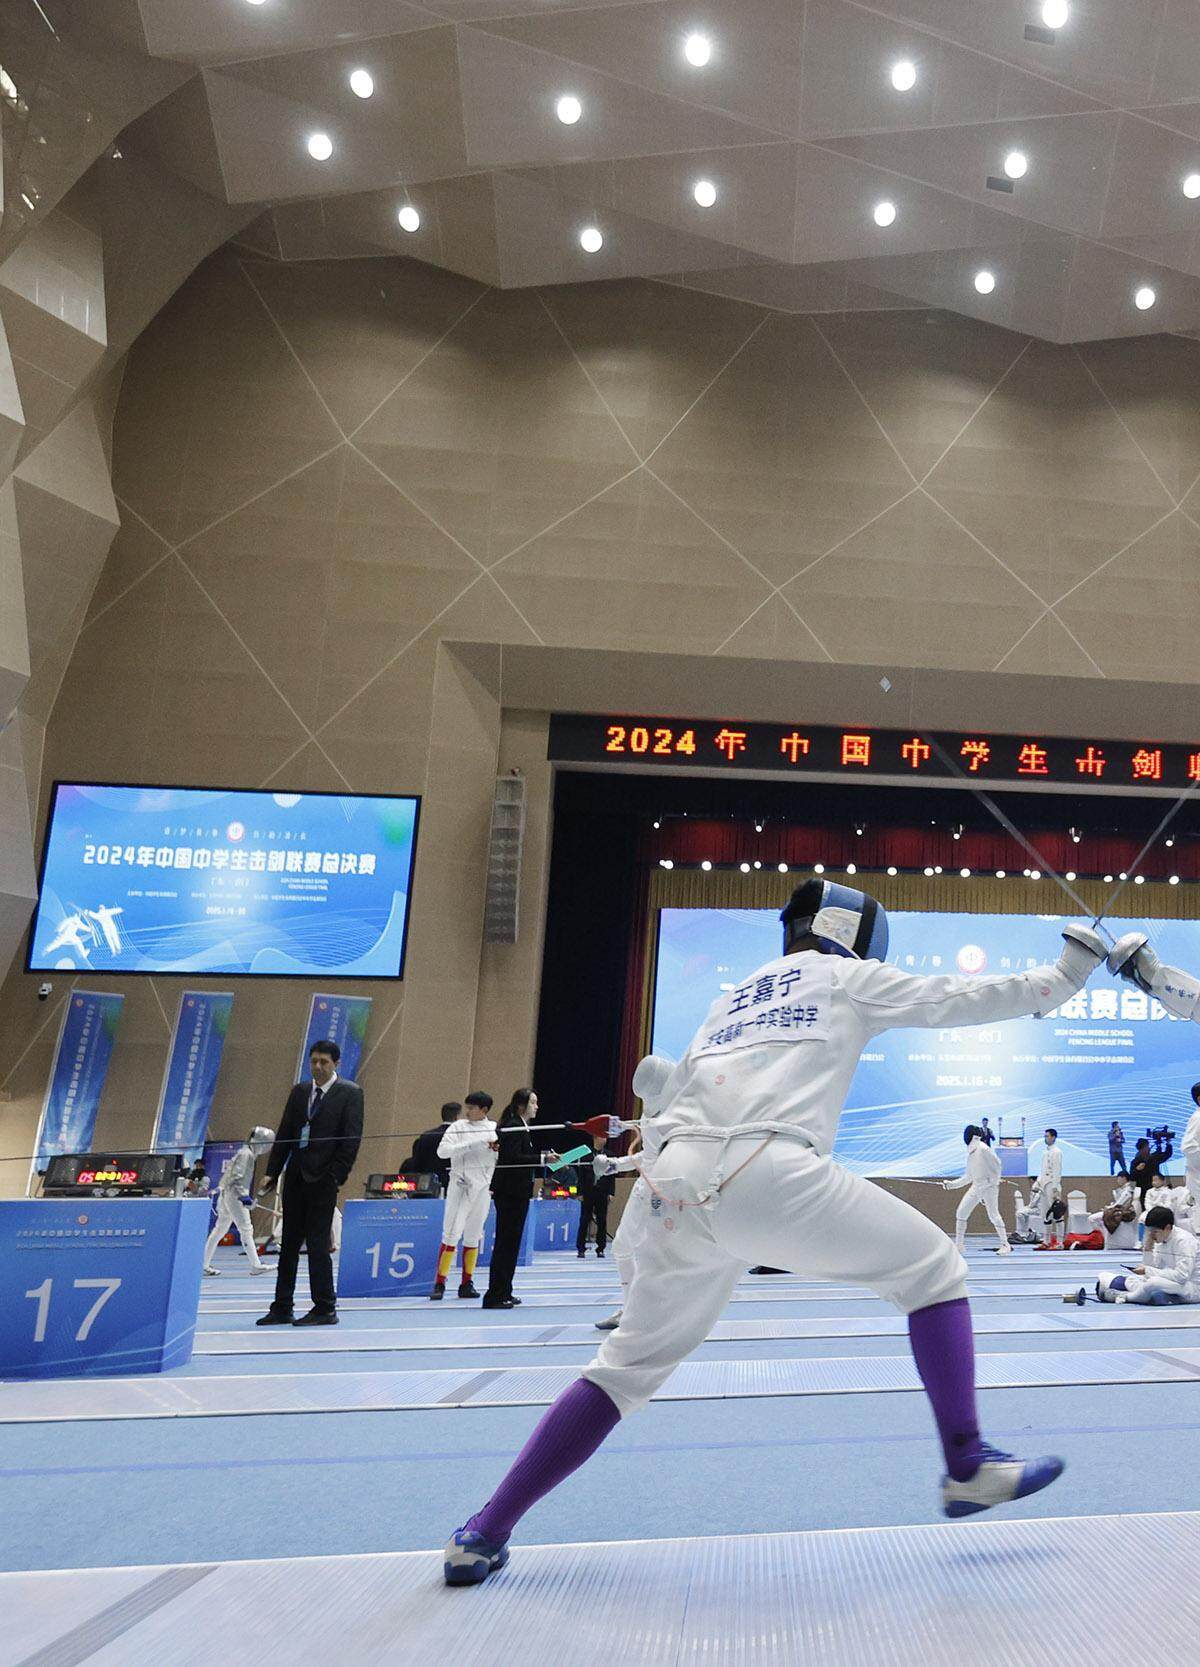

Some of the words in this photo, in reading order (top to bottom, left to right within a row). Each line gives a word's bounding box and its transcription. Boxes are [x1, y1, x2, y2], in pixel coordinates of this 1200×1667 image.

[83, 844, 377, 876] 2024年中国中学生击剑联赛总决赛
[727, 968, 801, 1015] 王嘉宁
[1109, 1029, 1135, 1037] SCHOOL
[546, 1222, 570, 1242] 11
[365, 1241, 415, 1279] 15
[24, 1278, 122, 1343] 17
